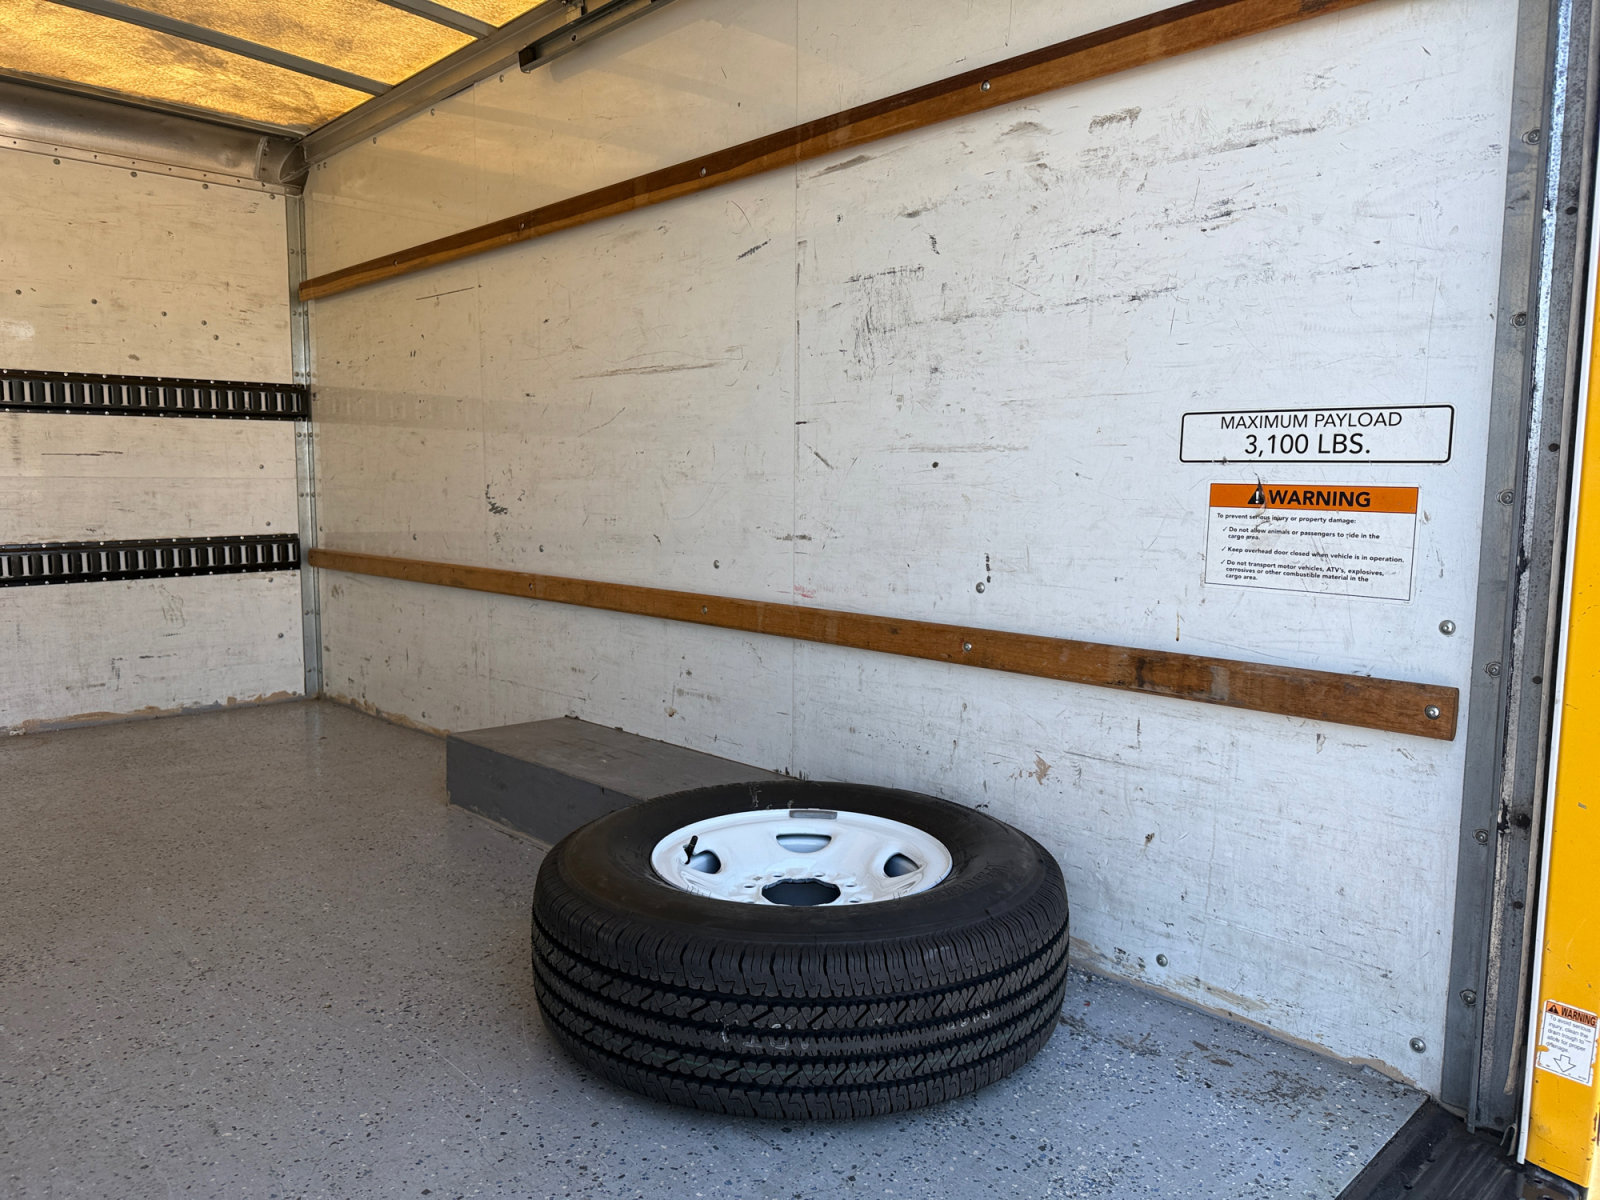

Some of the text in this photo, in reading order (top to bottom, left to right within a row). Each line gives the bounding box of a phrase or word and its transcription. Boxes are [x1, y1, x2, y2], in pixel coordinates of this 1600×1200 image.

[1220, 411, 1402, 430] MAXIMUM PAYLOAD
[1244, 433, 1370, 457] 3,100 LBS.
[1269, 489, 1371, 508] WARNING
[1272, 514, 1289, 522] injury
[1299, 515, 1327, 523] property
[1328, 516, 1356, 524] damage:
[1300, 530, 1336, 538] passengers
[1330, 552, 1353, 560] vehicle
[1369, 555, 1404, 563] operation.
[1248, 561, 1276, 569] transport
[1298, 564, 1324, 572] vehicles,
[1348, 567, 1384, 576] explosives,
[1283, 570, 1320, 578] combustible
[1322, 573, 1348, 581] material
[1550, 1014, 1592, 1033] To avoid serious
[1560, 1006, 1596, 1027] WARNING
[1579, 1031, 1589, 1039] the
